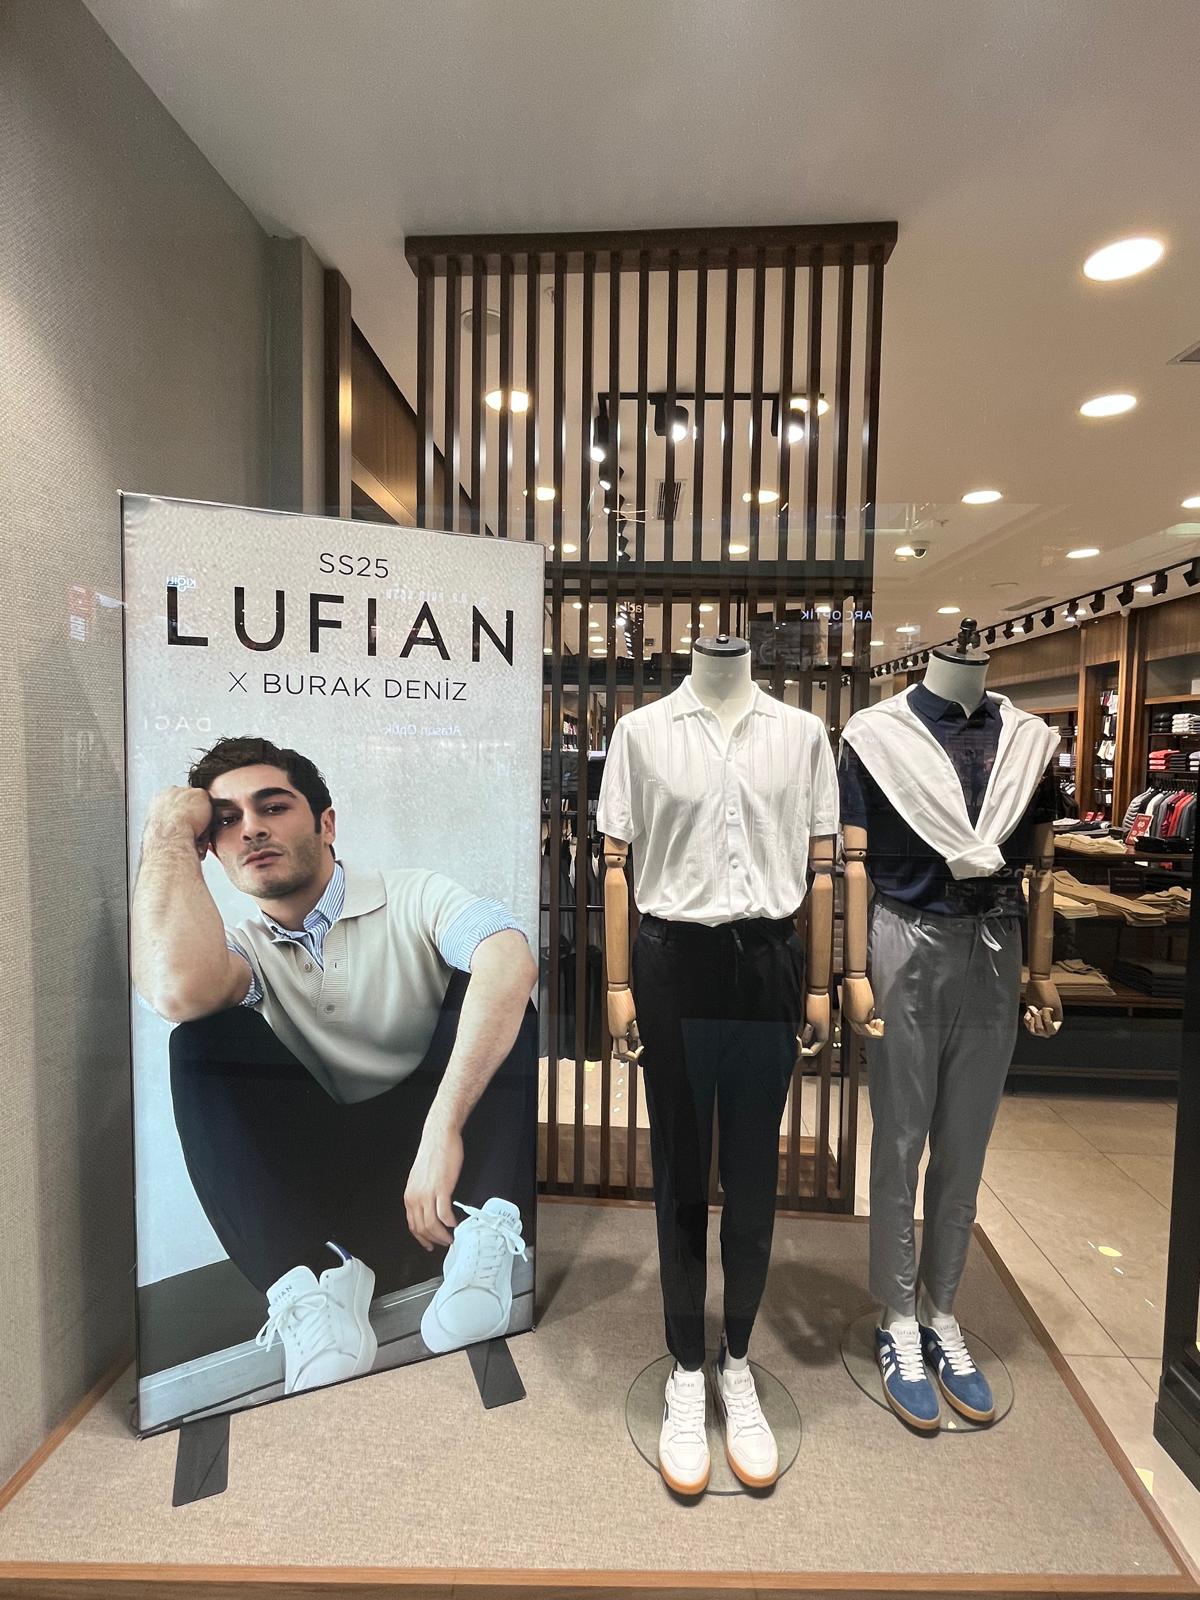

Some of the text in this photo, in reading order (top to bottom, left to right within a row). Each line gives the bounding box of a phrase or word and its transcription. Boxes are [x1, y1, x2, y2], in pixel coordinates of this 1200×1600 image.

[320, 553, 388, 578] SS25
[167, 586, 514, 666] LUFIAN
[229, 672, 466, 700] X BURAK DENİZ
